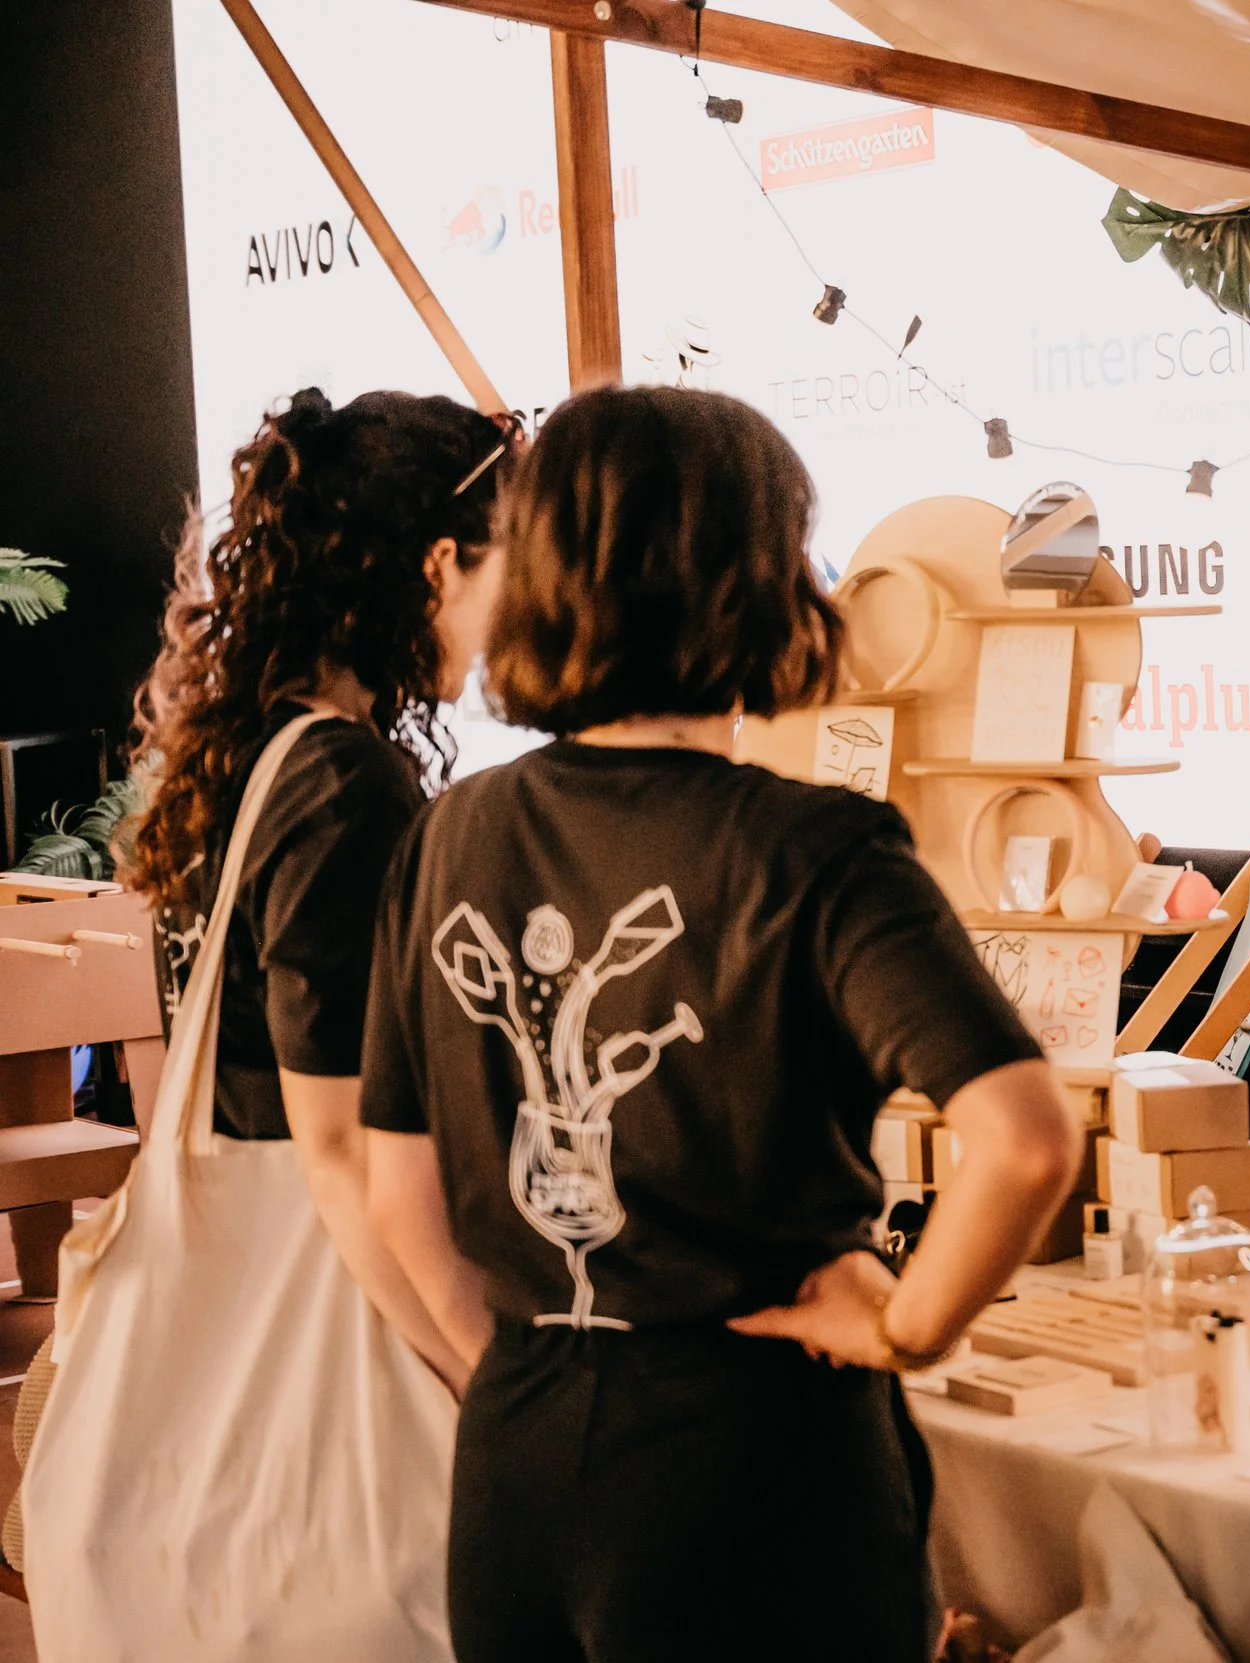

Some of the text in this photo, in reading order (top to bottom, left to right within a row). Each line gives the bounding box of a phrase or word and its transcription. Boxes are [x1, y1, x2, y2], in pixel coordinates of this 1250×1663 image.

[766, 121, 929, 175] Schützengarten
[518, 188, 560, 238] Re
[245, 219, 335, 287] AVIVO
